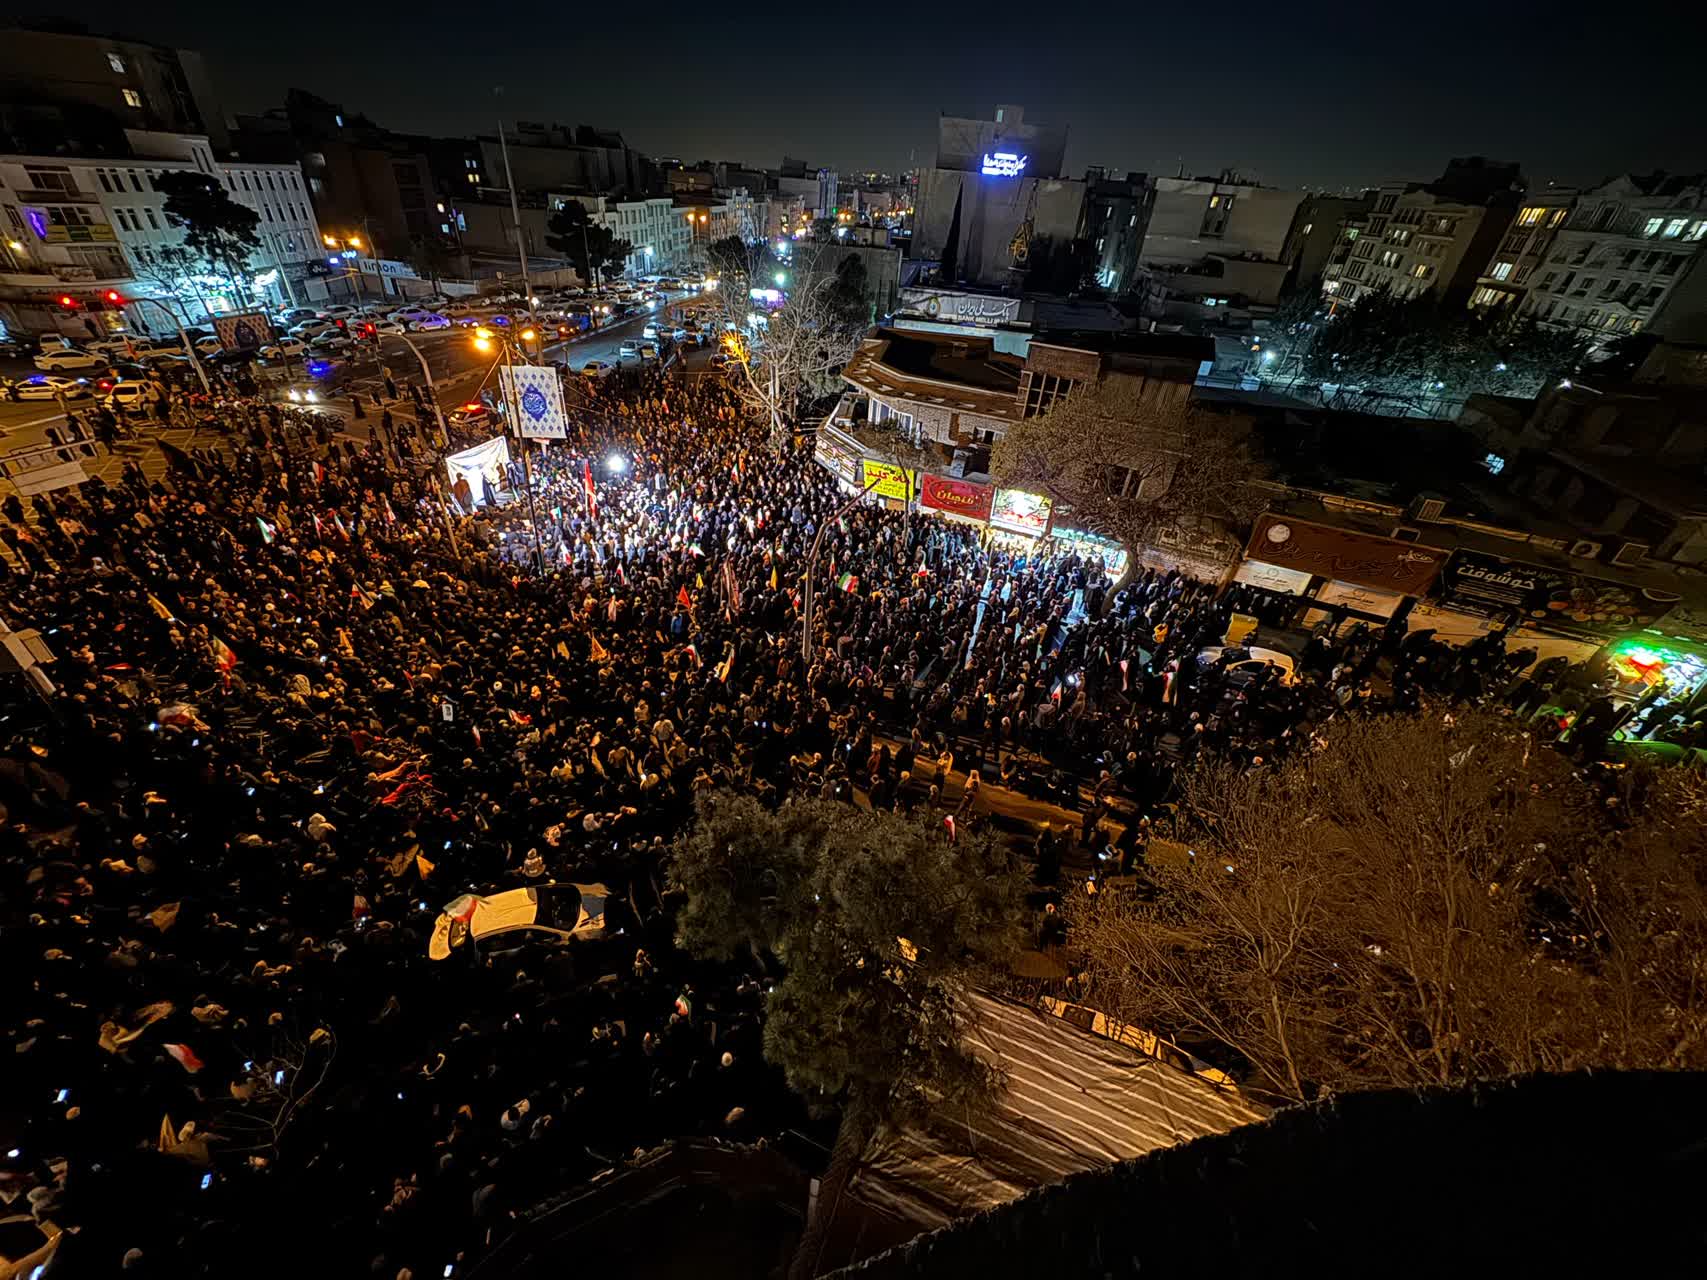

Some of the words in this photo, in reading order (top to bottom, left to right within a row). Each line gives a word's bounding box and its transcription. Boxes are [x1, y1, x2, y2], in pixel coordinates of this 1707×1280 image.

[958, 301, 975, 315] ایران
[982, 299, 1017, 320] بانک
[1457, 564, 1536, 590] خوشوقت
